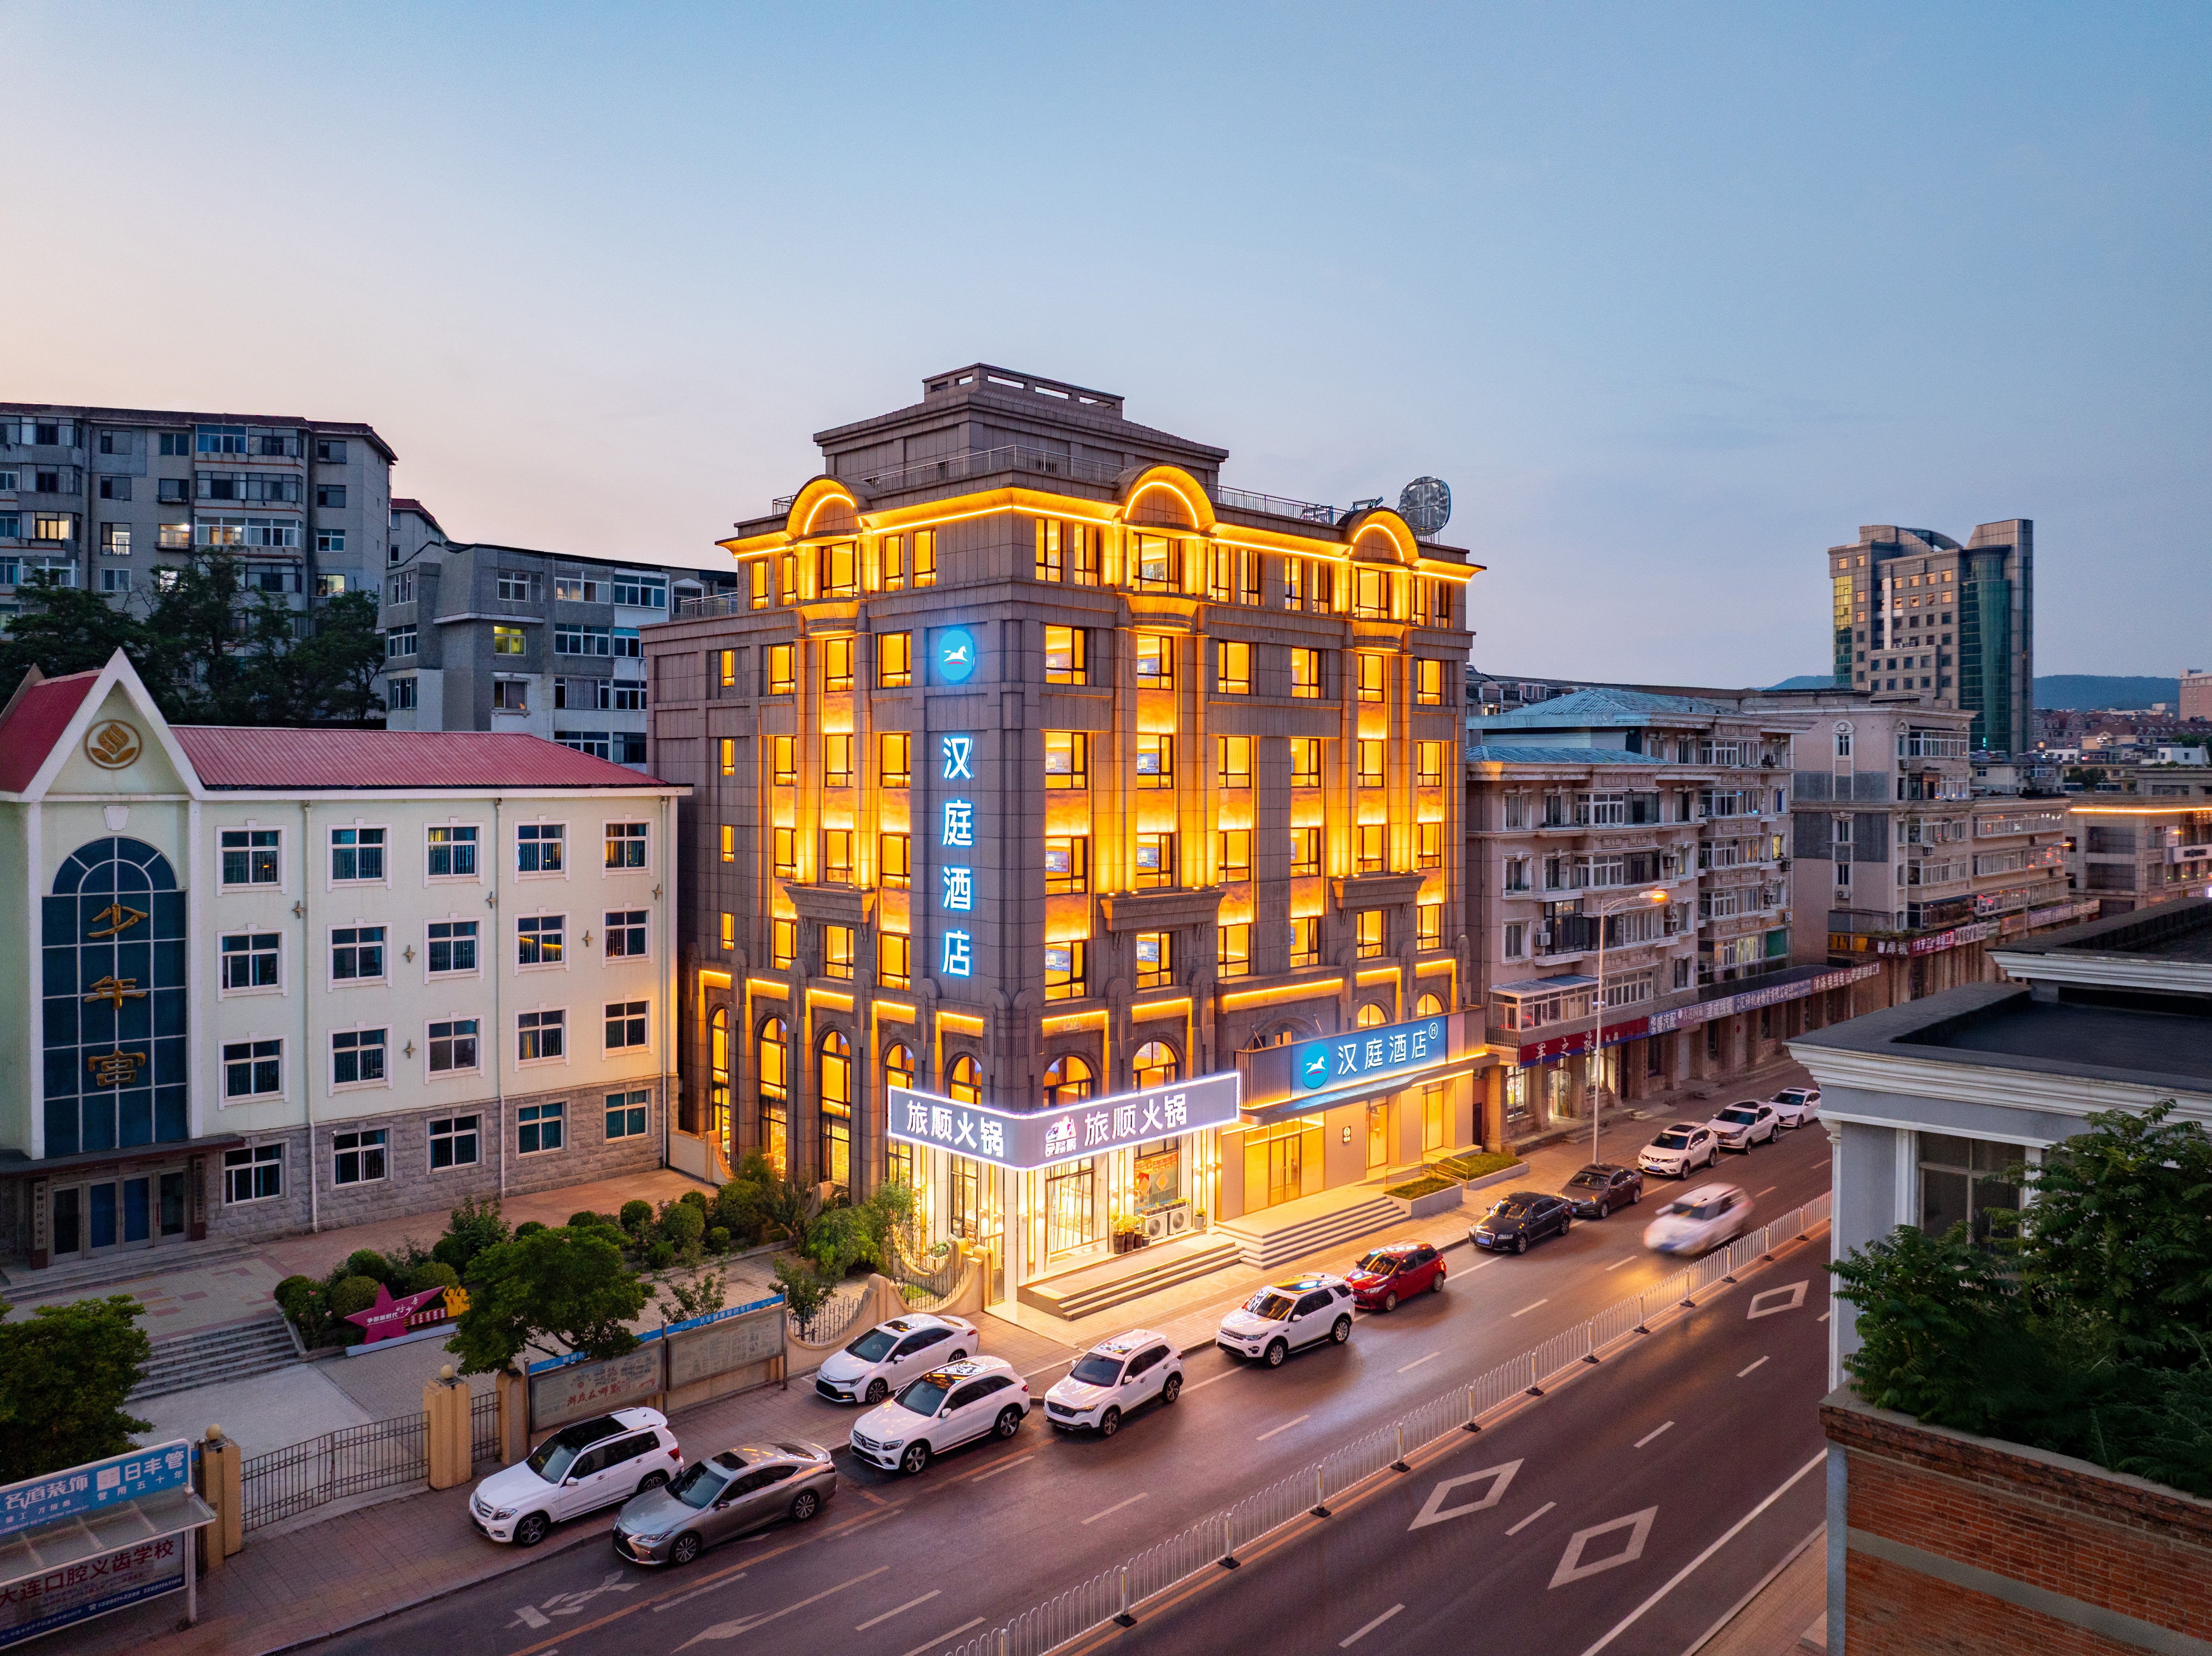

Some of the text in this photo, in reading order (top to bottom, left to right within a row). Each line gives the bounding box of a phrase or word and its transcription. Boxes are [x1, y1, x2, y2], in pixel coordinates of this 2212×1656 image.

[943, 736, 974, 977] 汉庭酒店
[84, 903, 148, 1087] 少年宫
[1606, 1031, 1619, 1043] 礼品
[1650, 1012, 1677, 1034] 华盛汽配
[1338, 1028, 1427, 1076] 汉庭酒店
[907, 1099, 1004, 1158] 旅顺火锅
[1084, 1092, 1188, 1146] 旅顺火锅
[700, 1304, 752, 1324] 卫生健康知识专栏
[97, 1470, 184, 1501] 管用五十年
[124, 1450, 185, 1482] 日丰管
[0, 1539, 174, 1608] 大连口腔义齿学校
